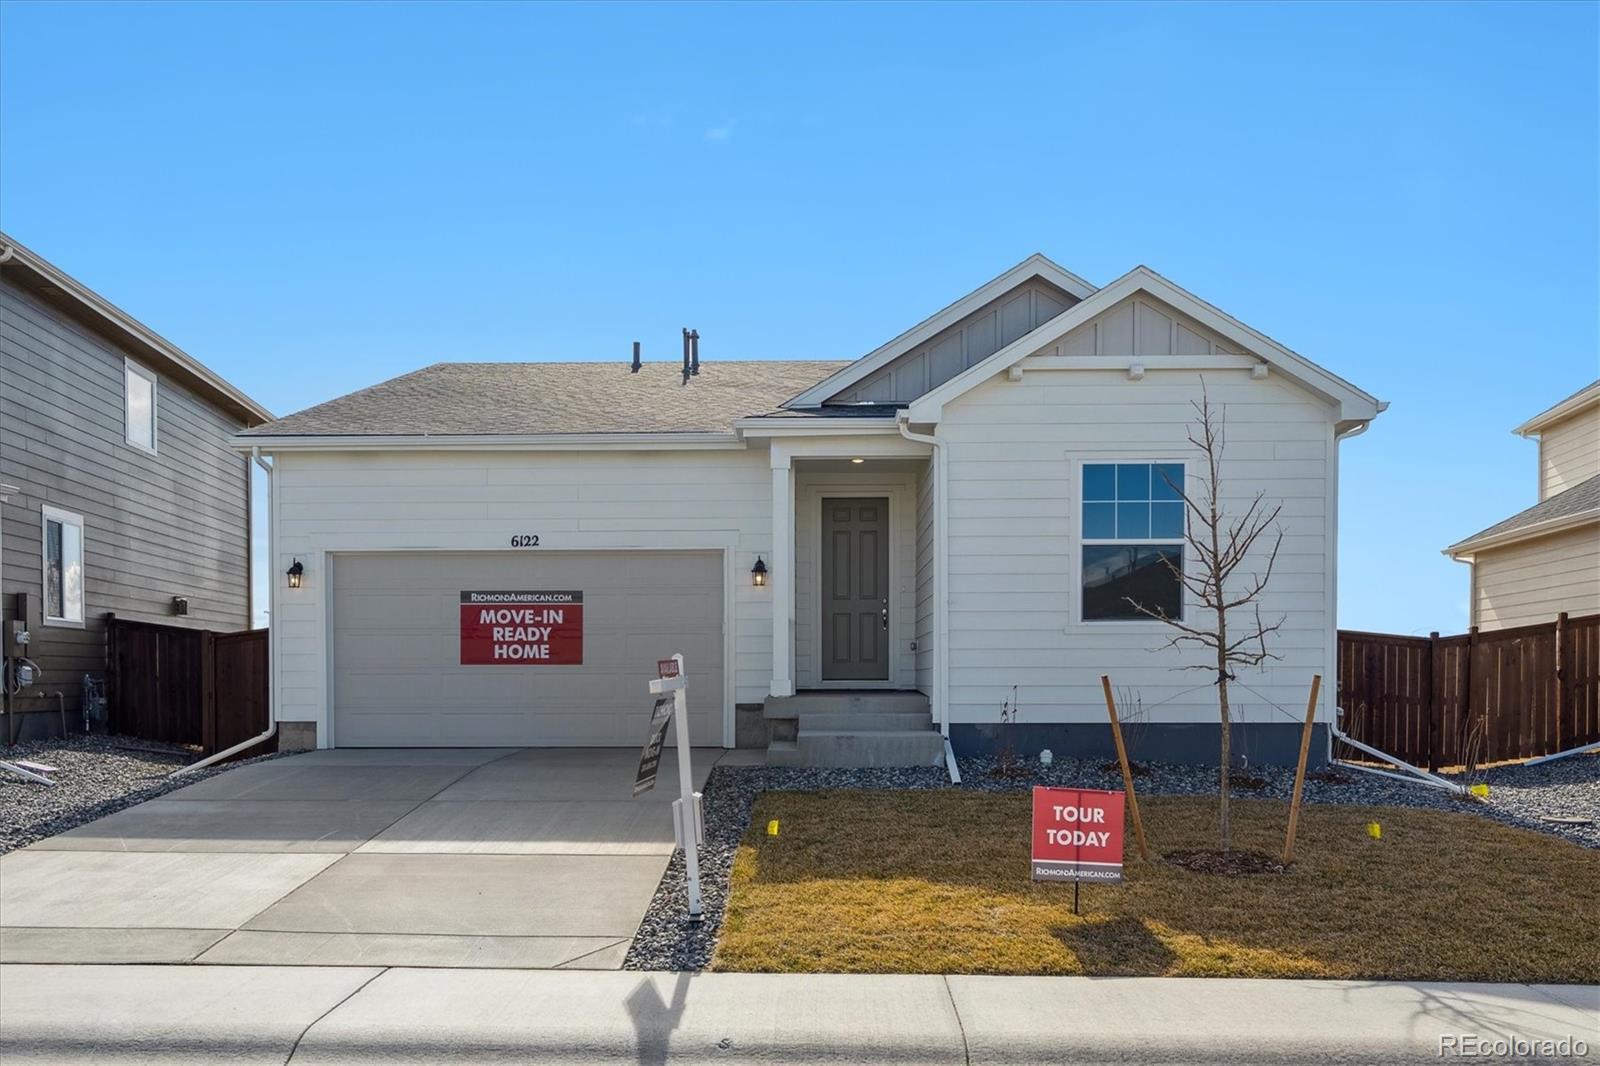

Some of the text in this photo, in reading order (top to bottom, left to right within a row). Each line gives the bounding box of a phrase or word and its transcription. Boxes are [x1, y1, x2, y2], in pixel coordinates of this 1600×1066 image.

[511, 535, 540, 547] 6122
[480, 610, 563, 624] MOVE-IN
[493, 627, 551, 641] READY
[494, 645, 550, 659] HOME
[1053, 805, 1105, 823] TOUR
[1046, 829, 1110, 847] TODAY
